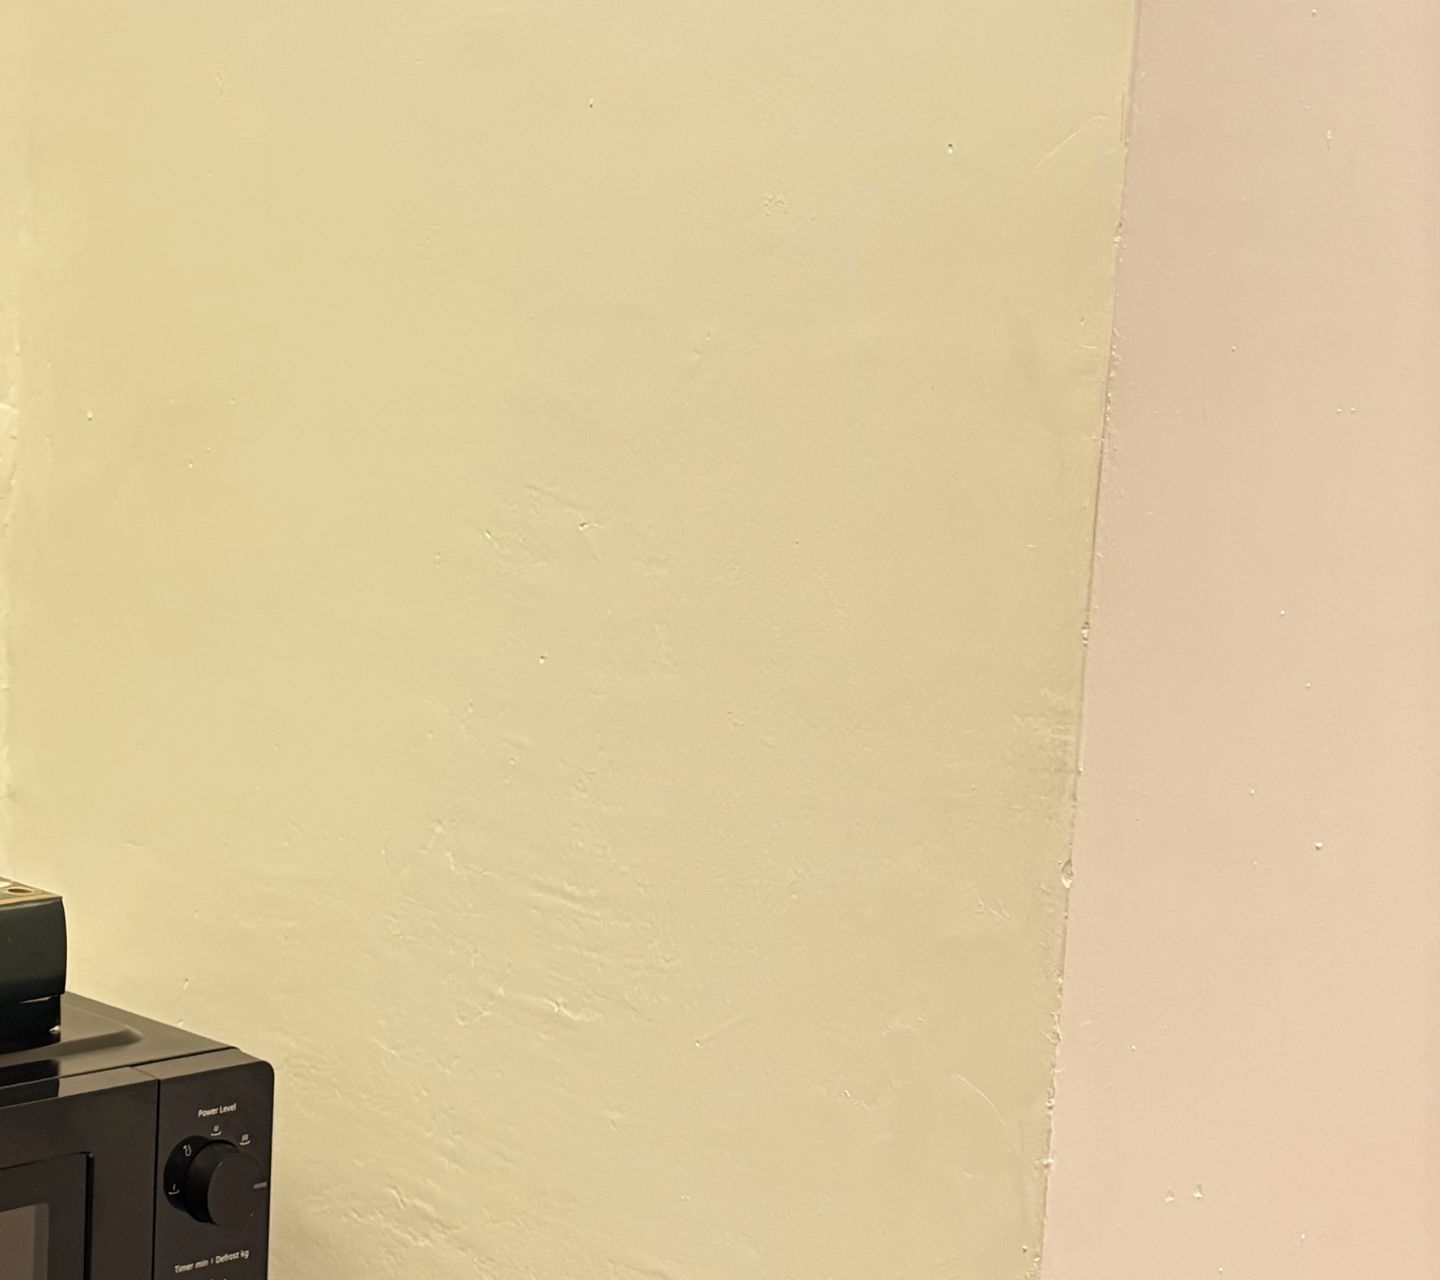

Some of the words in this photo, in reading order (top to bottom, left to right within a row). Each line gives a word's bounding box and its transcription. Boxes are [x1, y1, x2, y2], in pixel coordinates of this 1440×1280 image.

[198, 1108, 219, 1117] Power
[220, 1102, 237, 1114] Level
[174, 1263, 194, 1273] Timer
[215, 1251, 239, 1264] Defrost
[240, 1249, 250, 1259] kg
